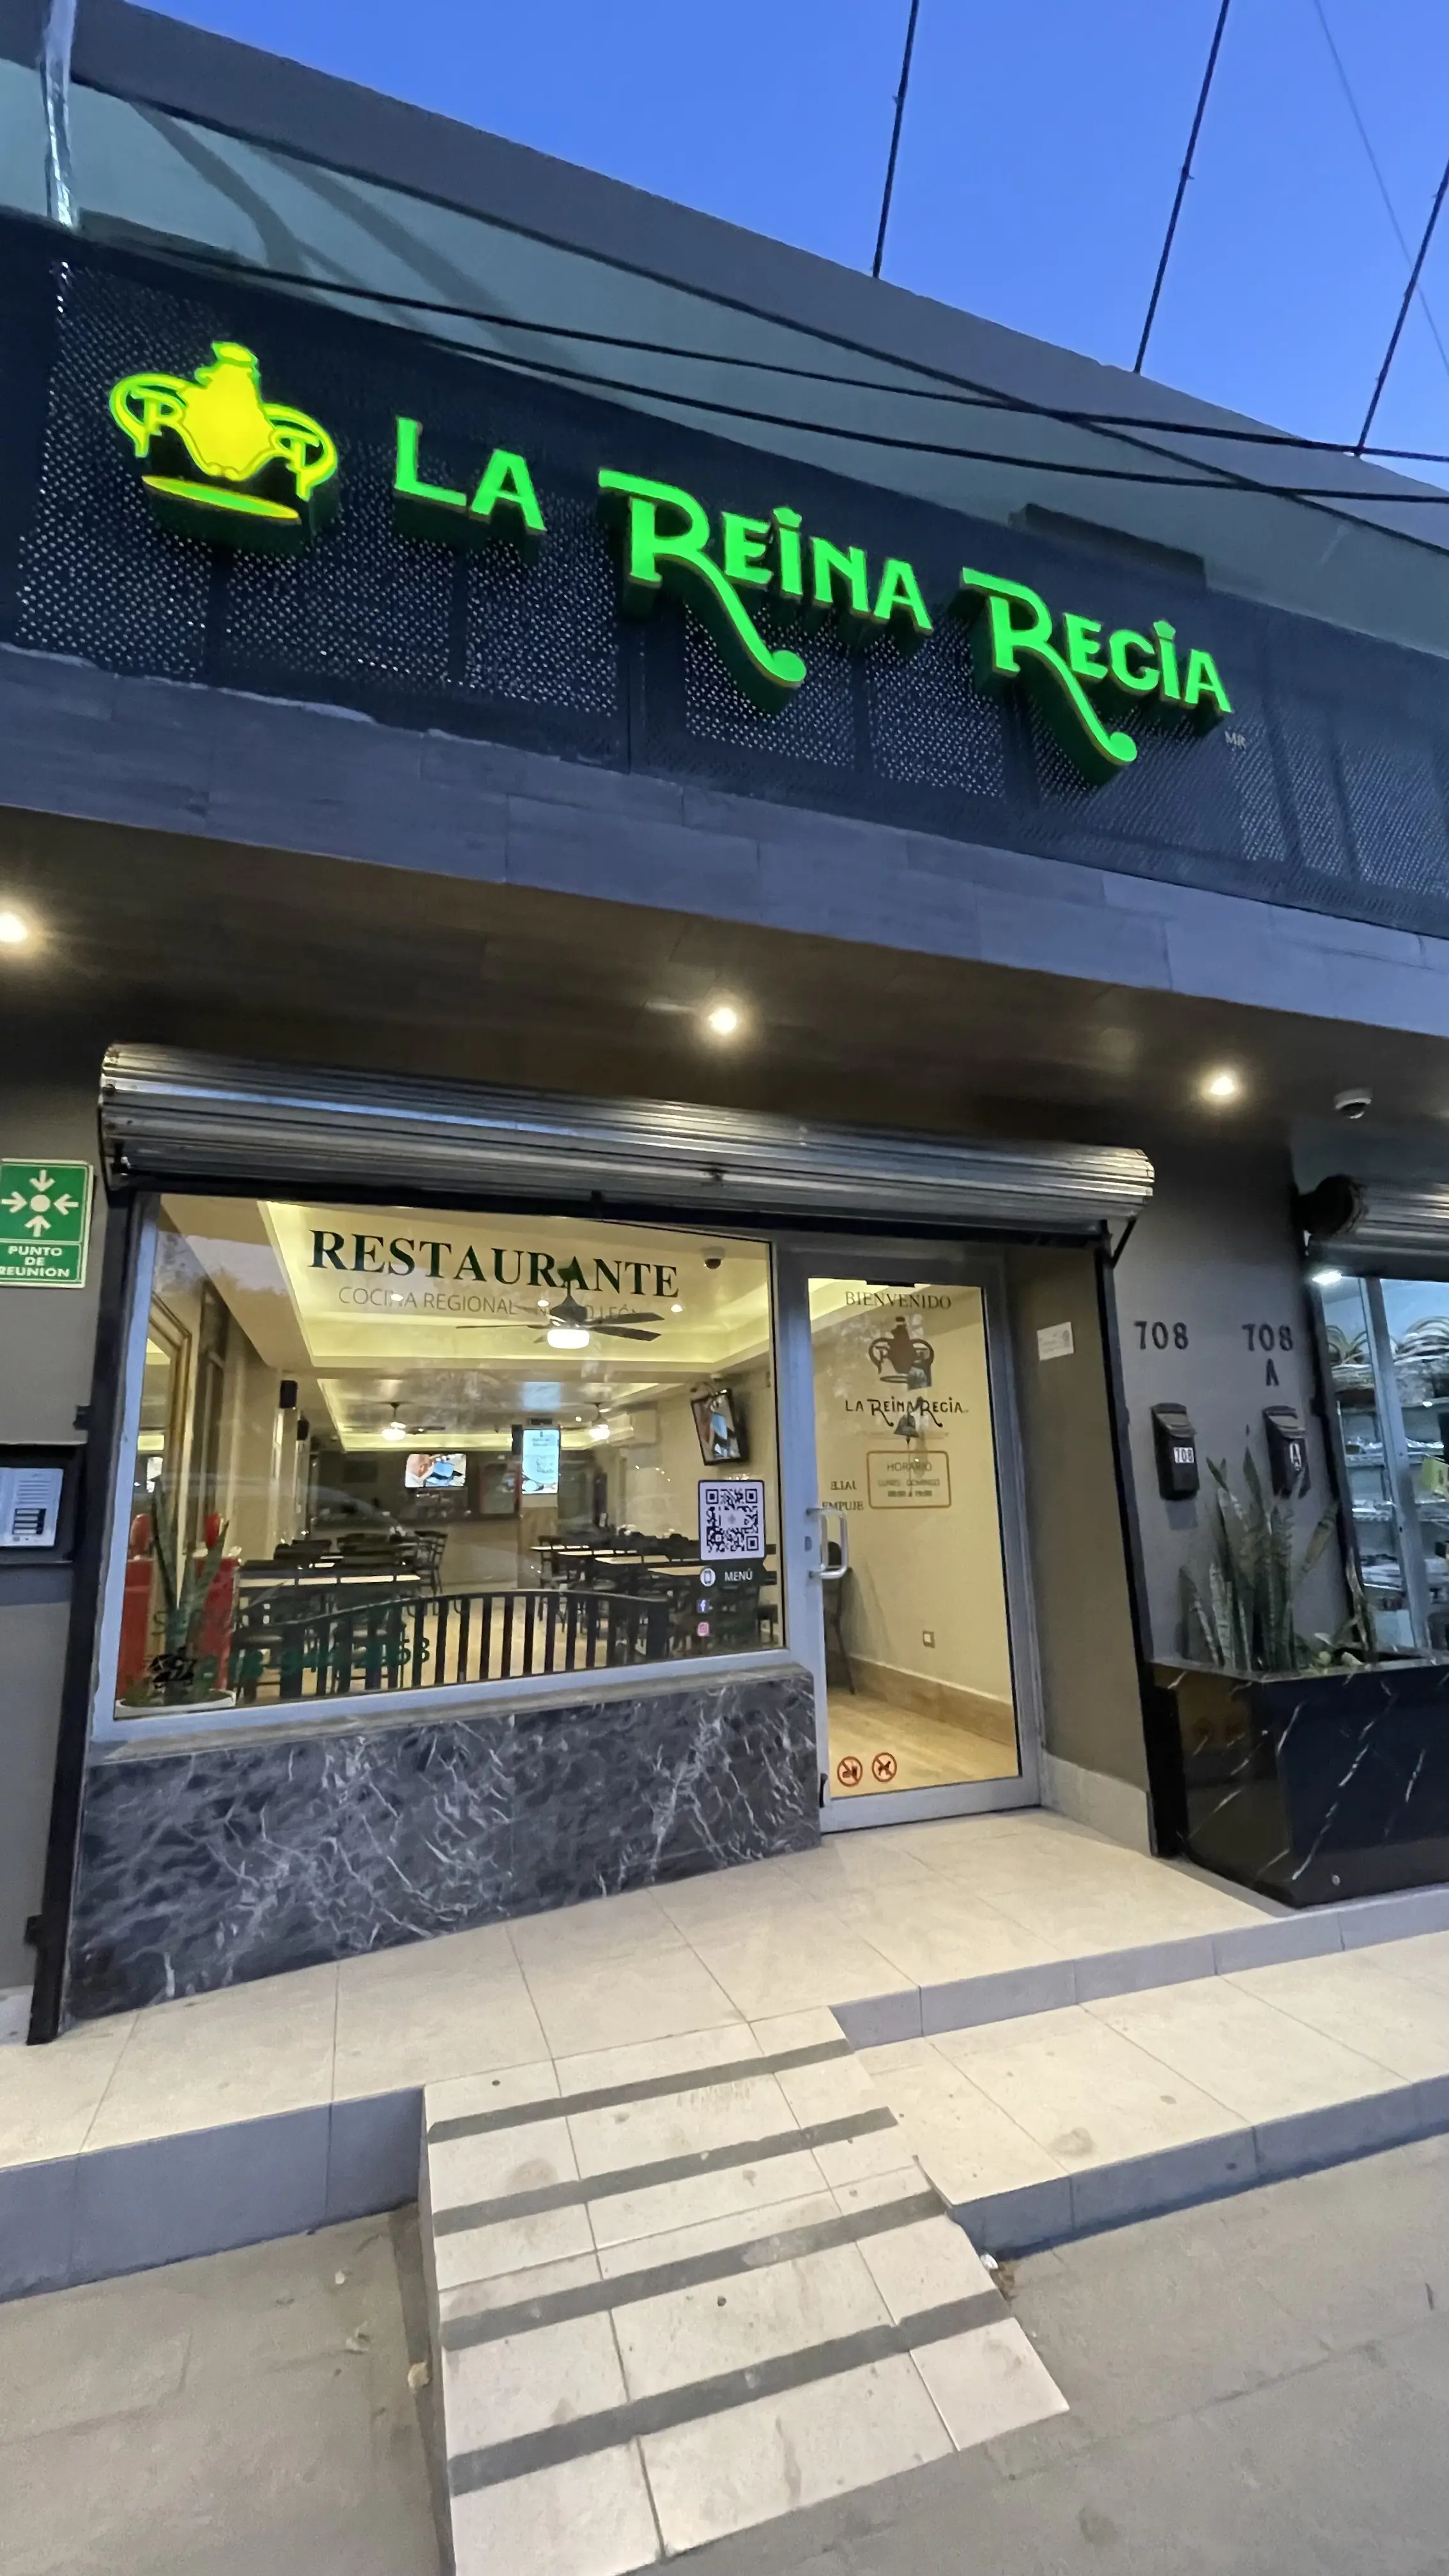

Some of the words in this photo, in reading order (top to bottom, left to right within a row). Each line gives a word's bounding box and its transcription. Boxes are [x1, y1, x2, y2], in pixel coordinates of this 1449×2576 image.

[395, 417, 547, 532] LA
[8, 1245, 63, 1257] PUNTO
[24, 1256, 45, 1266] DE
[309, 1229, 679, 1298] RESTAURANTE
[424, 1292, 518, 1315] REGIONAL
[845, 1291, 952, 1310] BIENVENIDO
[1133, 1321, 1189, 1350] 708
[1241, 1323, 1293, 1351] 708
[1266, 1358, 1279, 1386] A
[845, 1400, 864, 1412] LA
[1175, 1448, 1193, 1463] 708
[822, 1501, 864, 1512] EMPUJE
[724, 1568, 753, 1582] MENÚ
